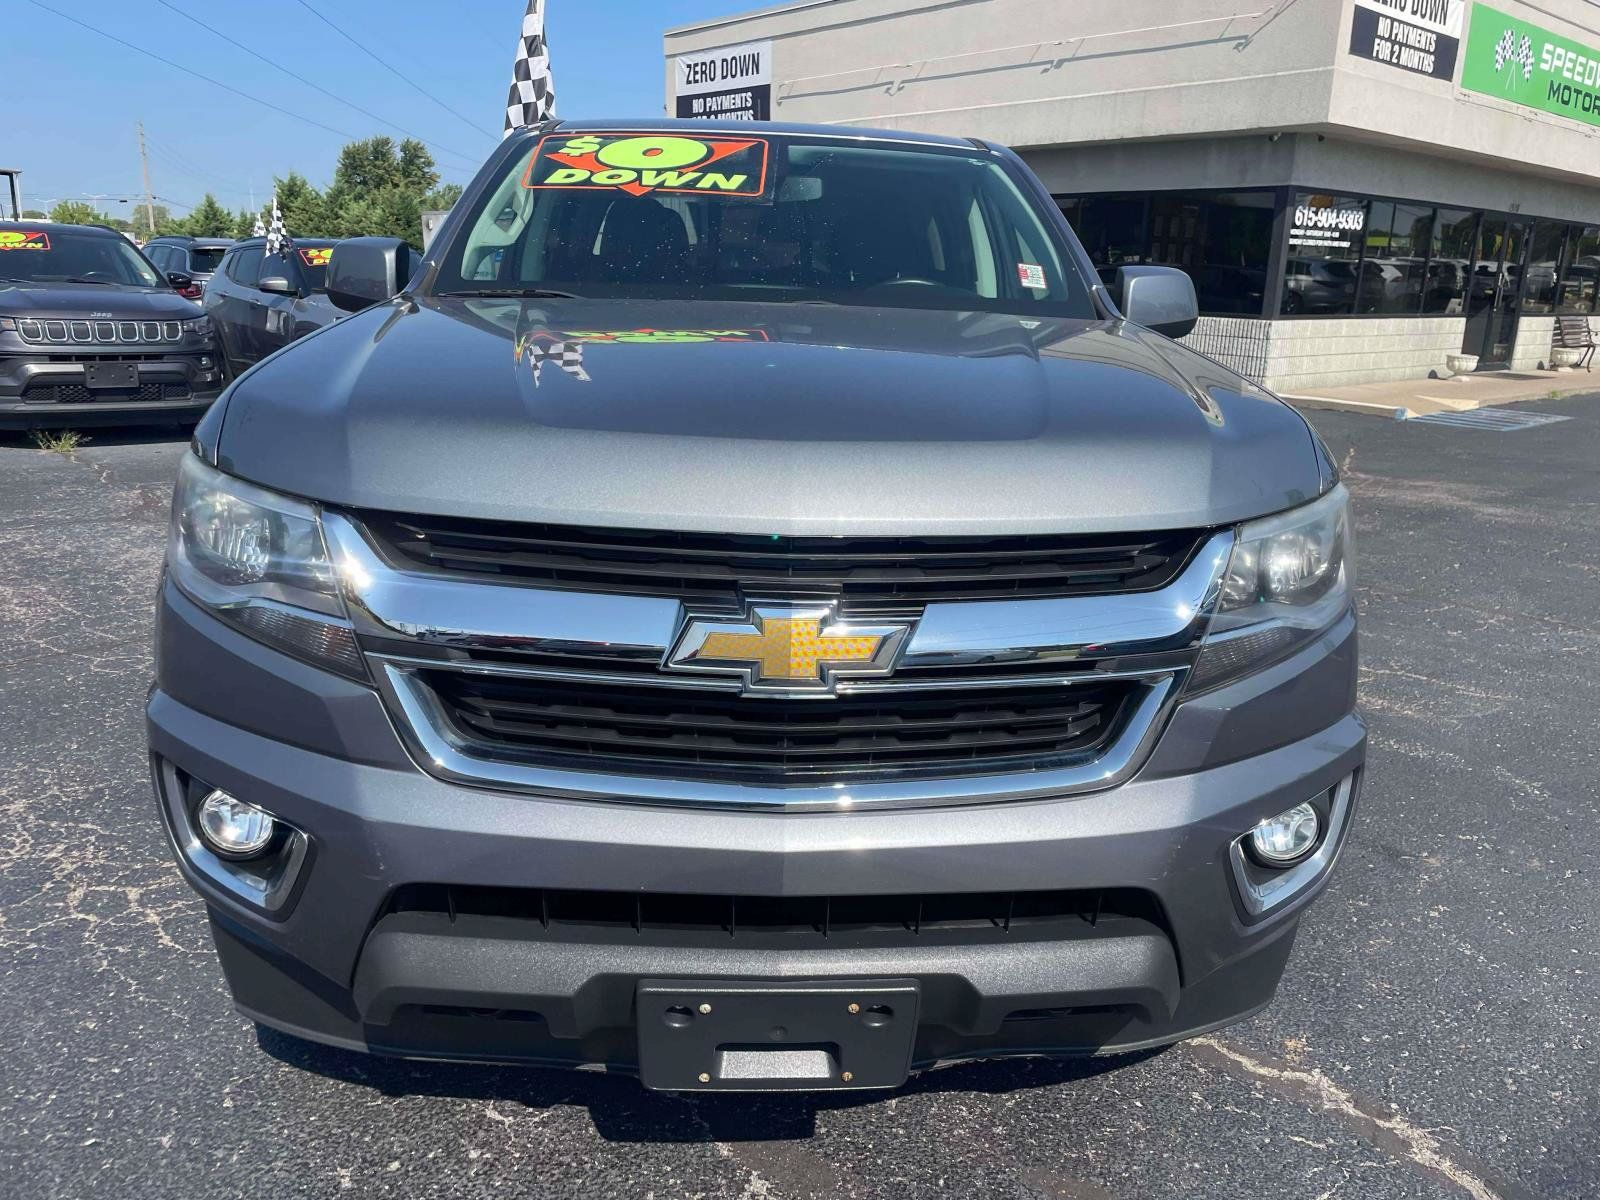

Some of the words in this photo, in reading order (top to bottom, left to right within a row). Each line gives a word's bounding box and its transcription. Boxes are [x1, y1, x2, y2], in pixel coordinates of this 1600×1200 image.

[1377, 16, 1391, 38] NO
[1391, 21, 1436, 52] PAYMENTS
[686, 60, 716, 85] ZERO
[721, 52, 760, 80] DOWN
[1373, 38, 1391, 61] FOR
[1391, 44, 1400, 63] 2
[1399, 46, 1435, 74] MONTHS
[692, 98, 704, 113] NO
[706, 92, 752, 112] PAYMENTS
[544, 168, 748, 190] DOWN
